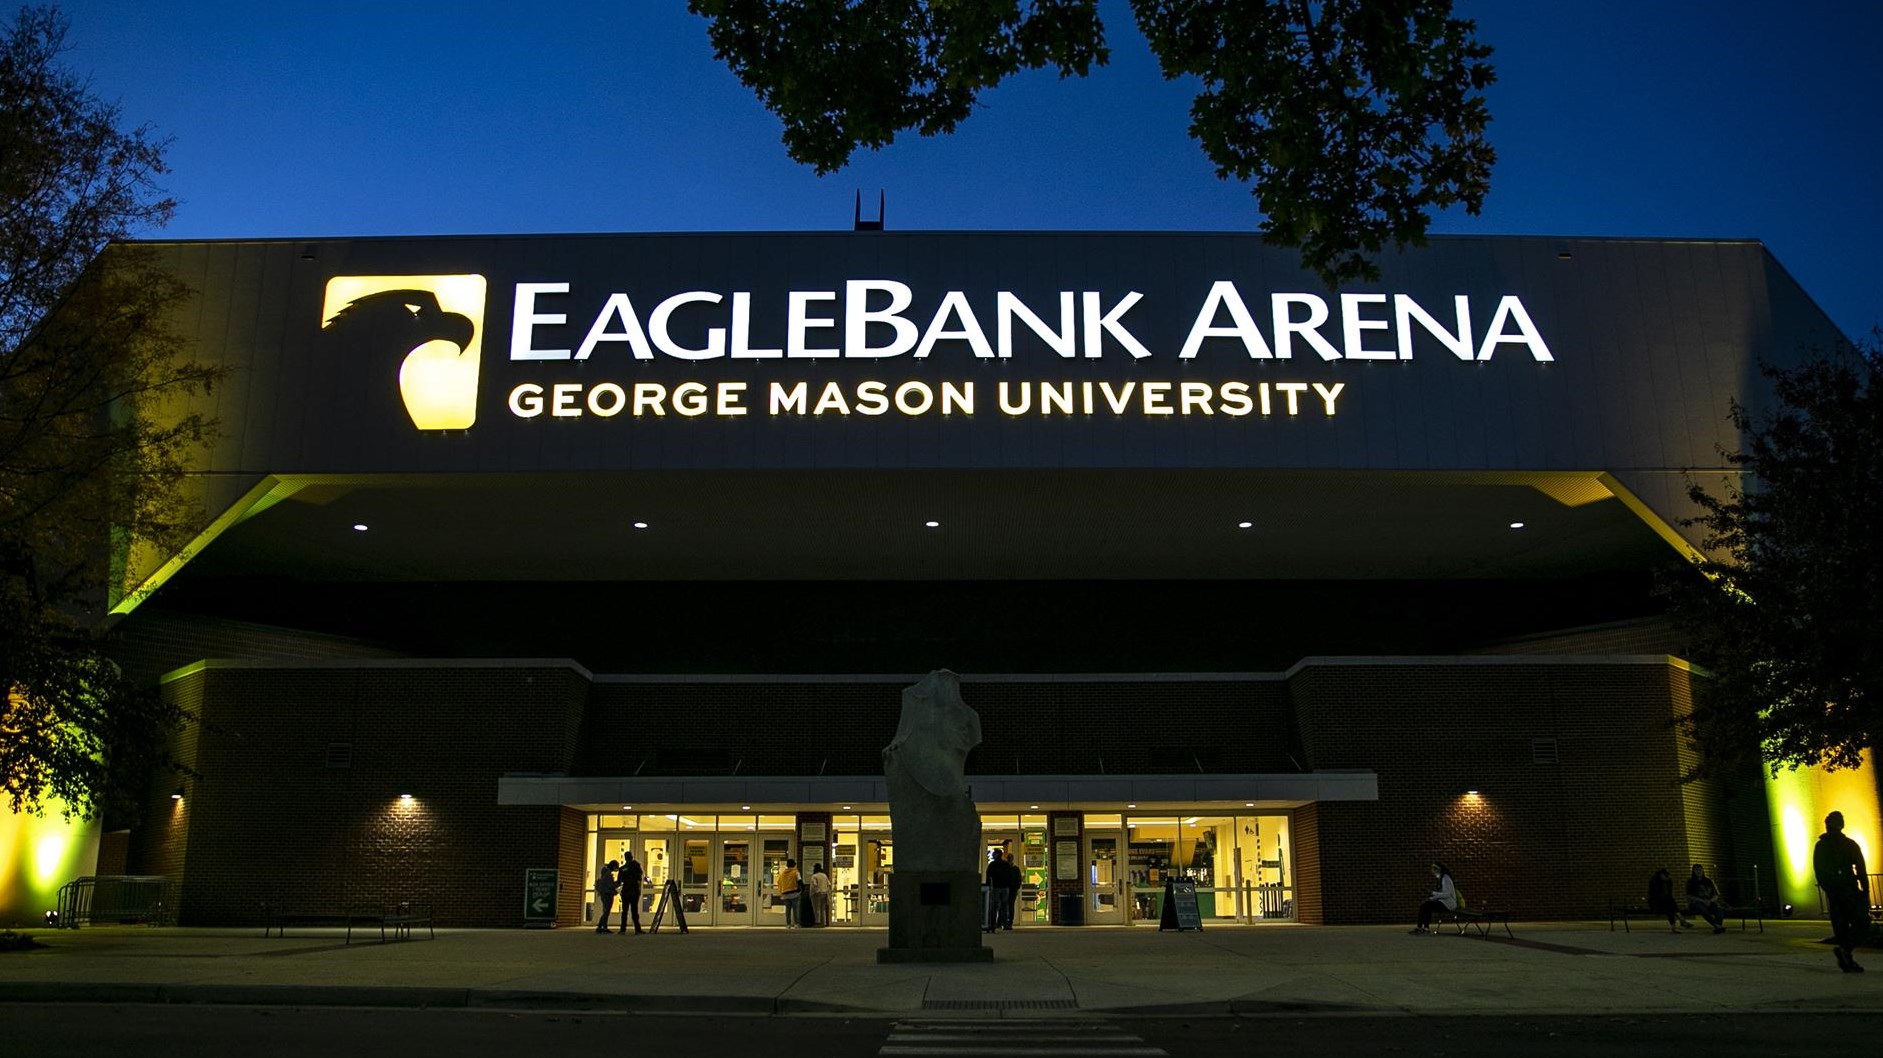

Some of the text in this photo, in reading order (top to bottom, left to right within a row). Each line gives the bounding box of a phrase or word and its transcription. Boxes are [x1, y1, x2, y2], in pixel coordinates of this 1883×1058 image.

[1178, 280, 1555, 362] ARENA
[508, 381, 1345, 418] GEORGE MASON UNIVERSITY
